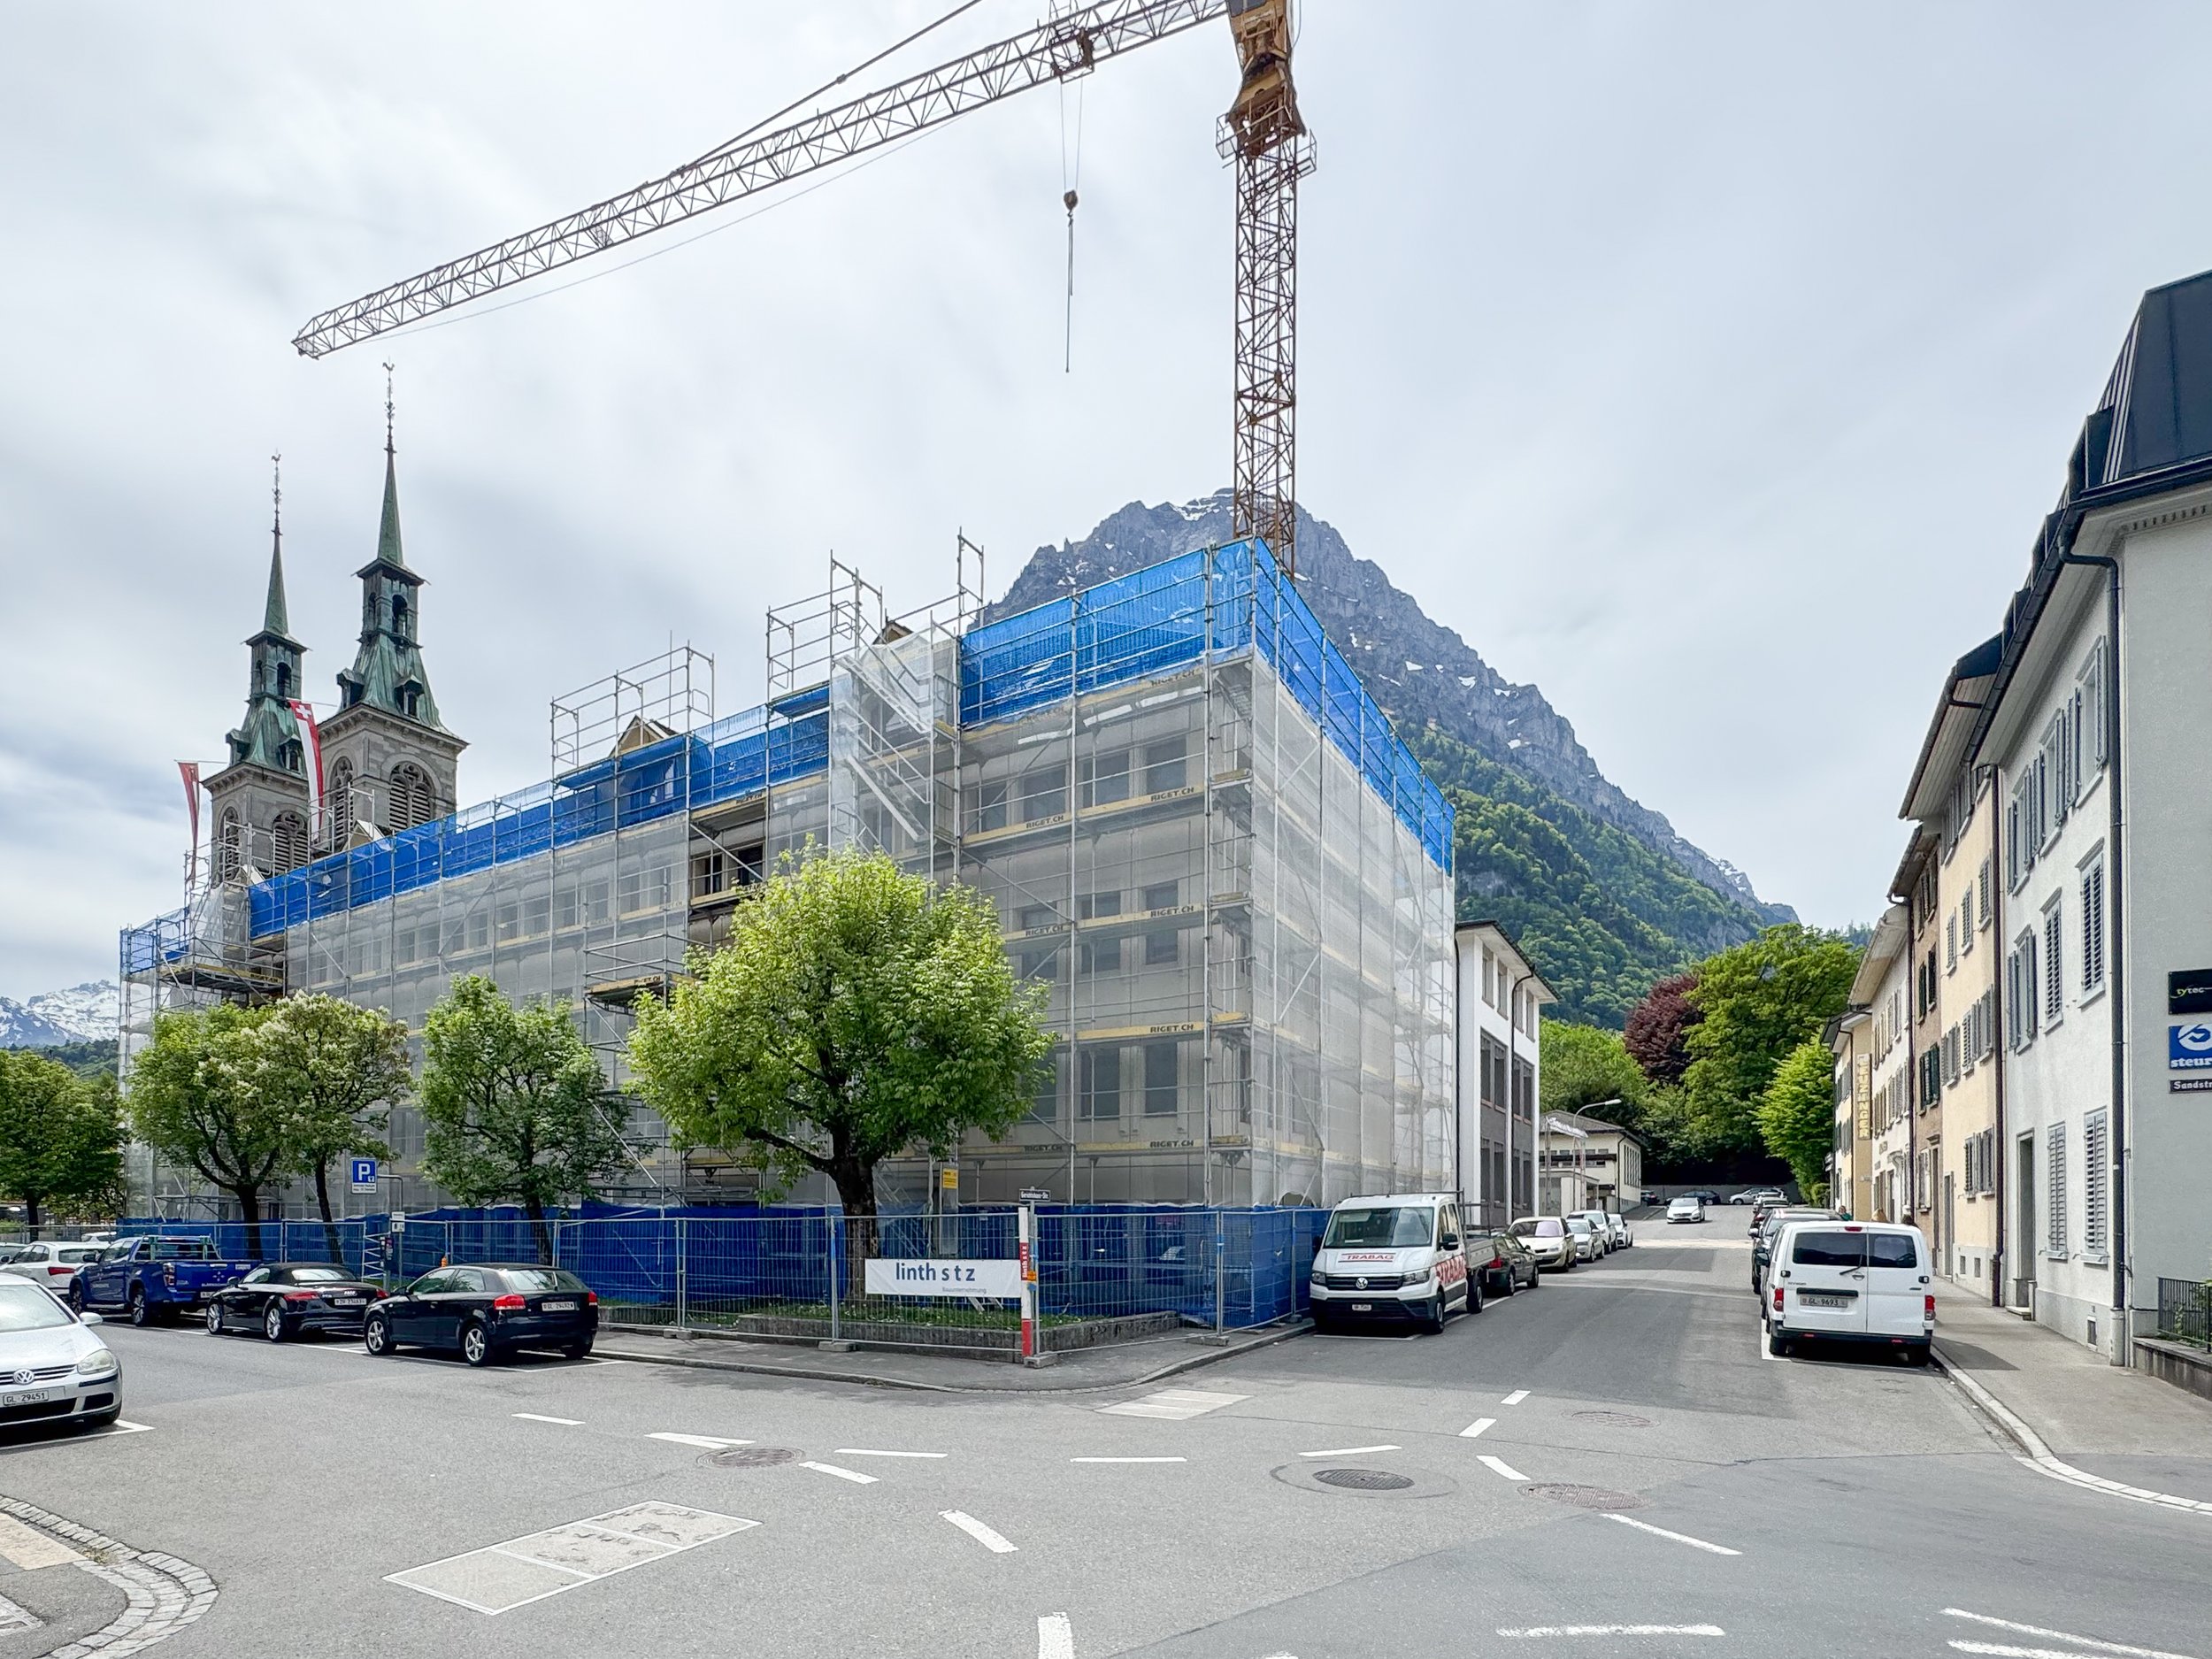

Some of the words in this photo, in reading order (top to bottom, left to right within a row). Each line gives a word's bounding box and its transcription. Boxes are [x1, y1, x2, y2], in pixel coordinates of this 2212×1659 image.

[1150, 787, 1194, 802] RIGET.CH
[1025, 815, 1064, 829] RIGET.CH
[1150, 905, 1194, 918] RIGET.CH
[1150, 1024, 1194, 1033] RIGET.CH
[1150, 1140, 1194, 1148] RIGET.CH
[357, 1163, 371, 1181] P
[895, 1262, 936, 1281] linth
[21, 1392, 45, 1402] 29451
